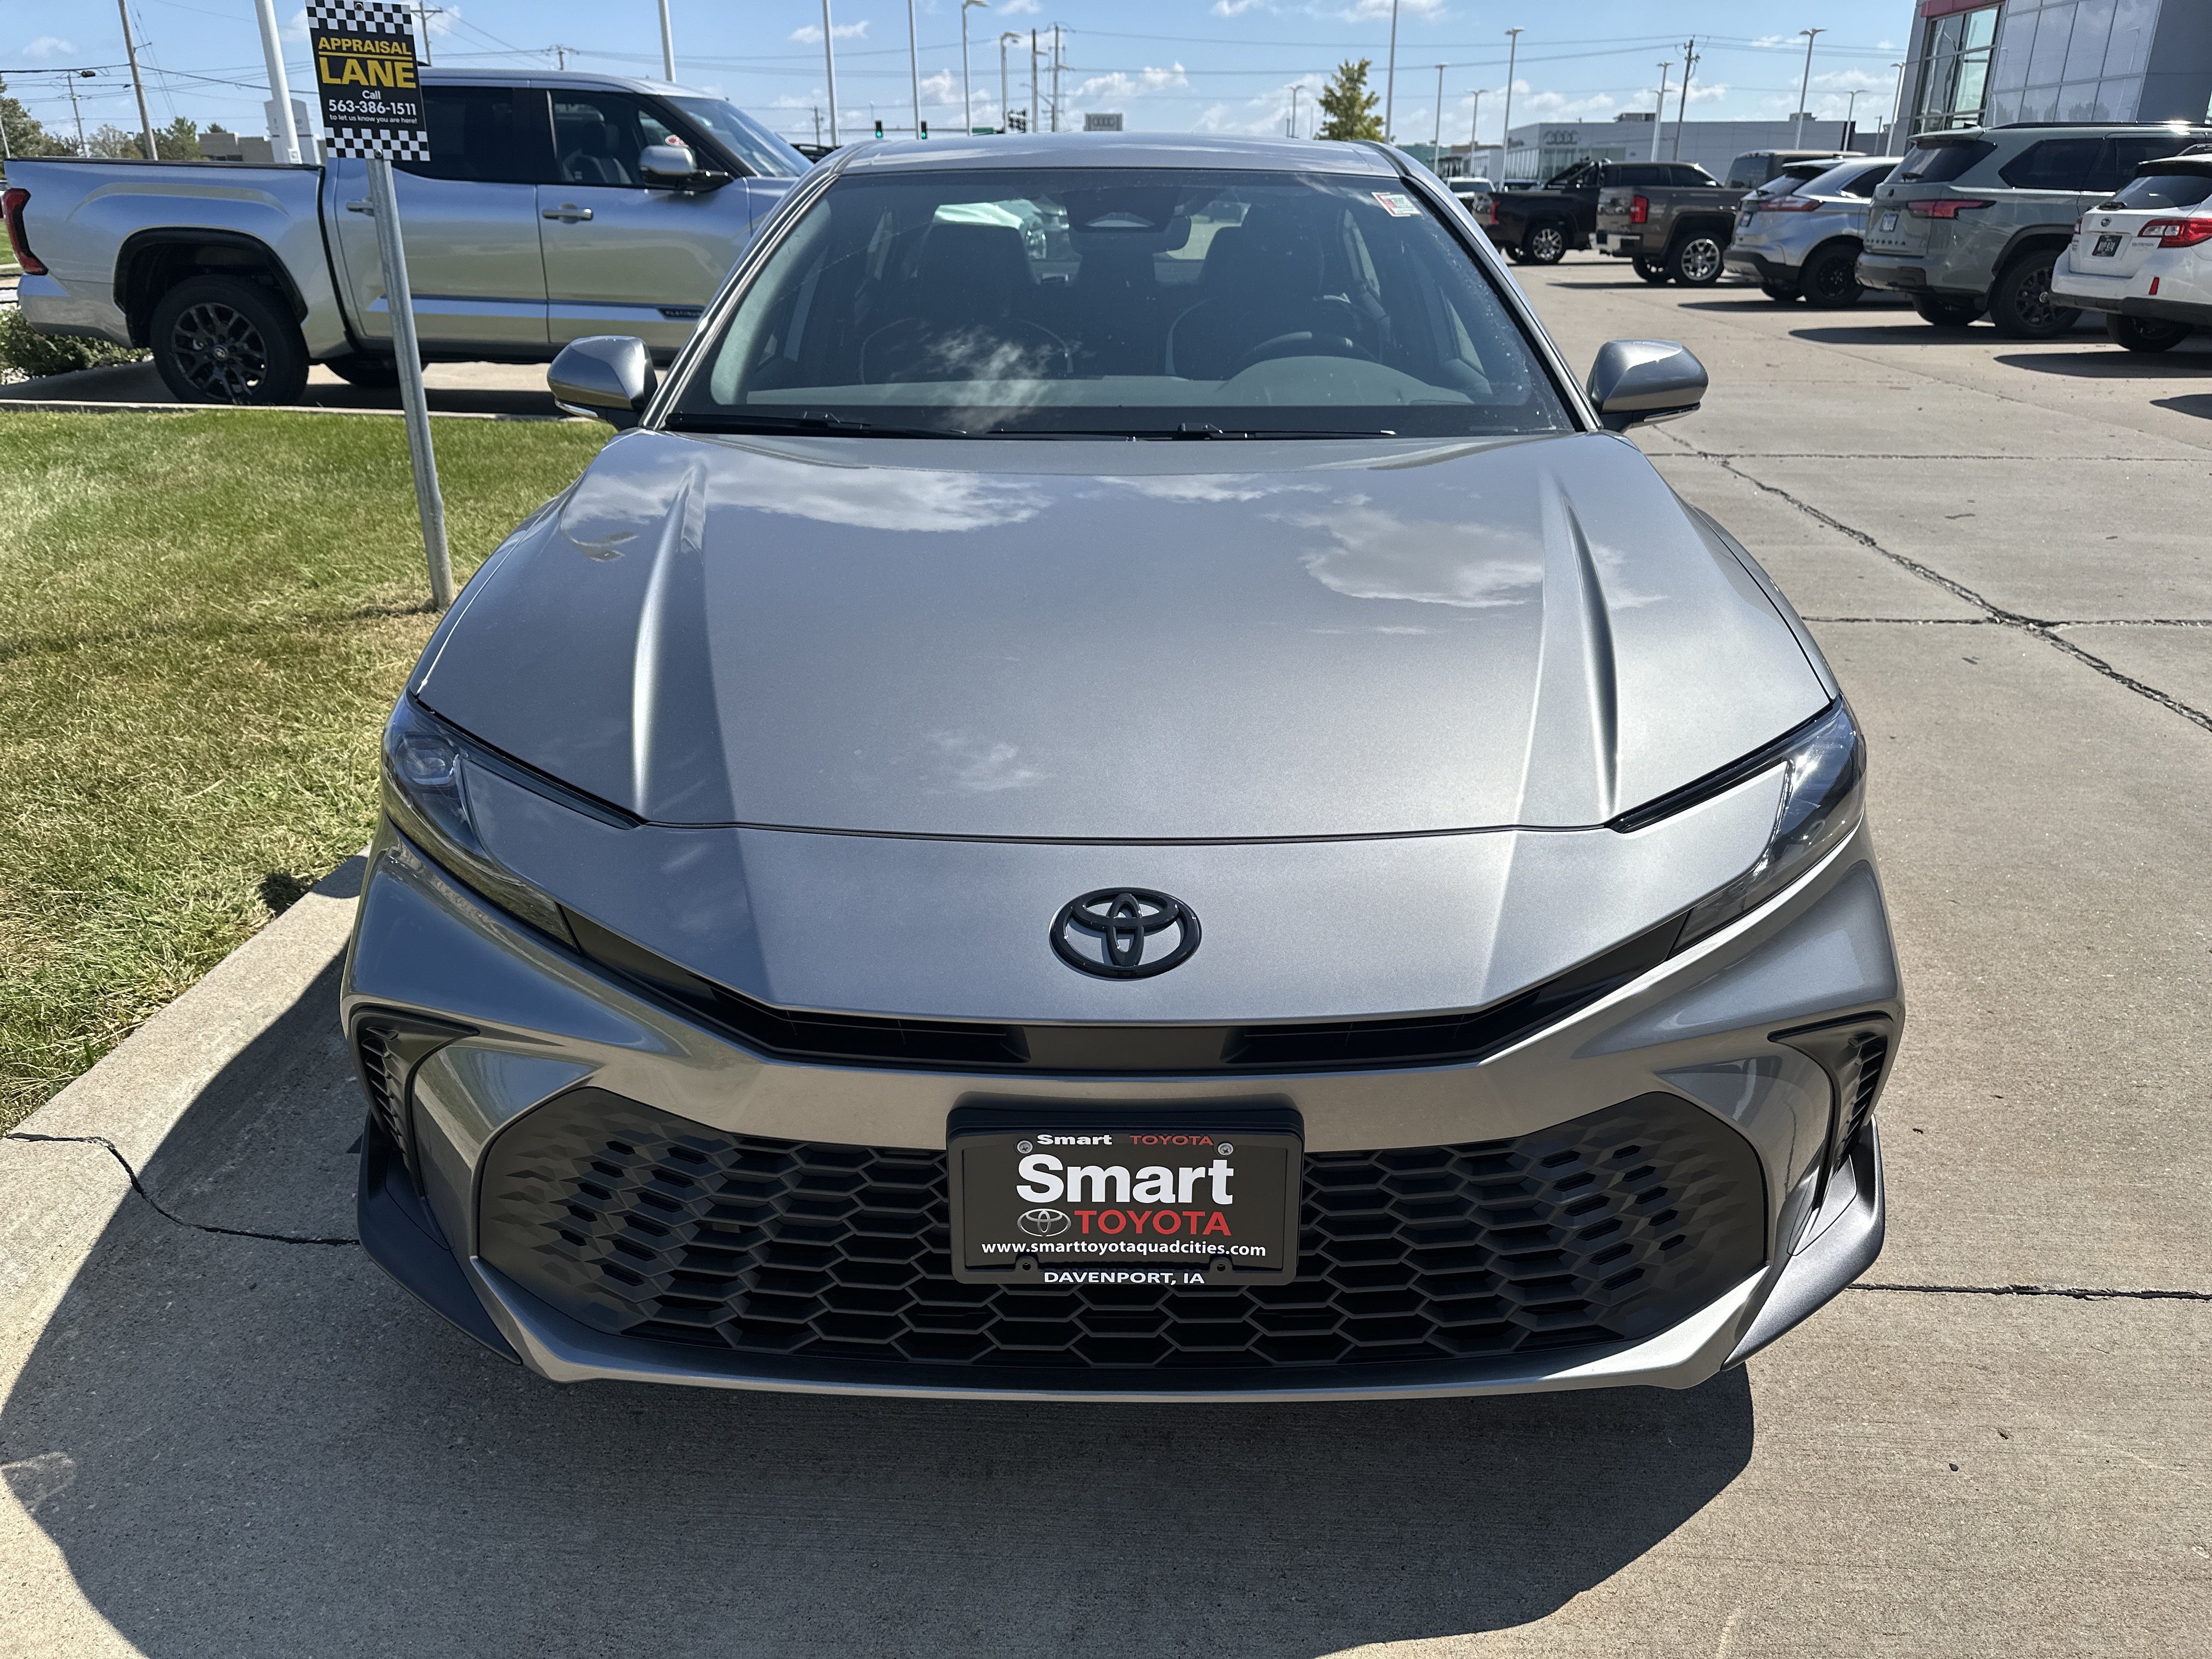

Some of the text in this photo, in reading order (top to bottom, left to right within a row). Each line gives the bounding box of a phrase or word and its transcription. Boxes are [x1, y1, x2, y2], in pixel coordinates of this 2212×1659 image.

[318, 37, 411, 55] APPRAISAL
[319, 57, 416, 88] LANE
[362, 90, 381, 100] Call
[329, 99, 417, 116] 563-386-1511
[1037, 1134, 1214, 1146] Smart TOYOTA
[1016, 1154, 1234, 1205] Smart
[1074, 1210, 1232, 1236] TOYOTA
[981, 1240, 1266, 1256] www.smarttoyotaquadcities.com
[1043, 1272, 1205, 1285] DAVENPORT, IA
